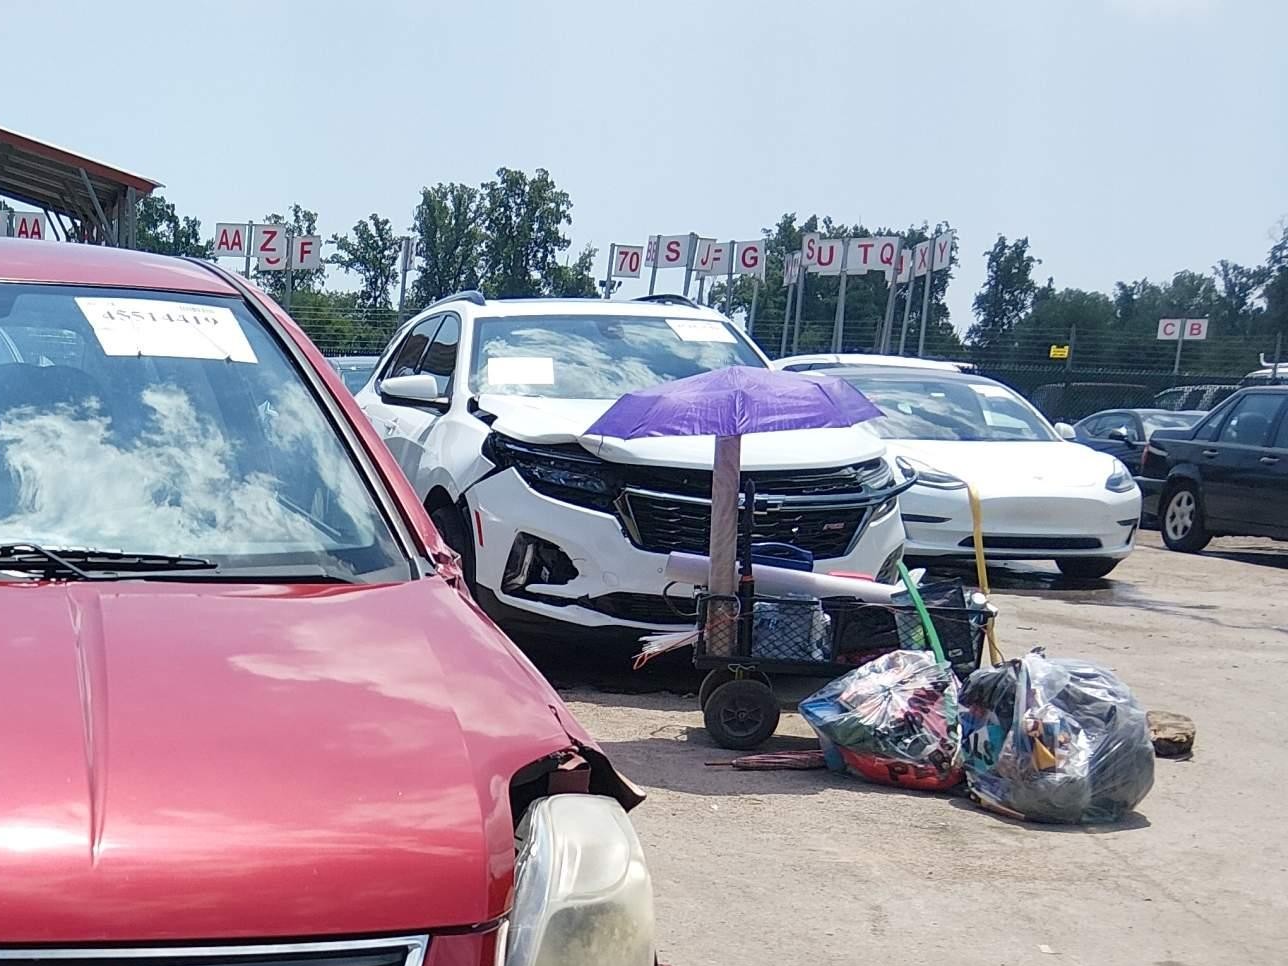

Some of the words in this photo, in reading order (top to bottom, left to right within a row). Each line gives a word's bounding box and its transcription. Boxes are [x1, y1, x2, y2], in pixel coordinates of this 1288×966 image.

[17, 217, 42, 240] AA
[217, 228, 243, 251] AA
[260, 230, 278, 252] Z
[300, 241, 313, 263] F
[665, 240, 681, 263] S
[807, 238, 815, 260] S
[938, 240, 948, 263] Y
[618, 250, 641, 273] 70
[700, 243, 711, 266] J
[741, 246, 759, 268] G
[817, 245, 834, 266] U
[858, 244, 874, 264] T
[880, 242, 894, 266] Q
[918, 247, 928, 270] X
[1163, 323, 1175, 335] C
[1189, 323, 1202, 336] B
